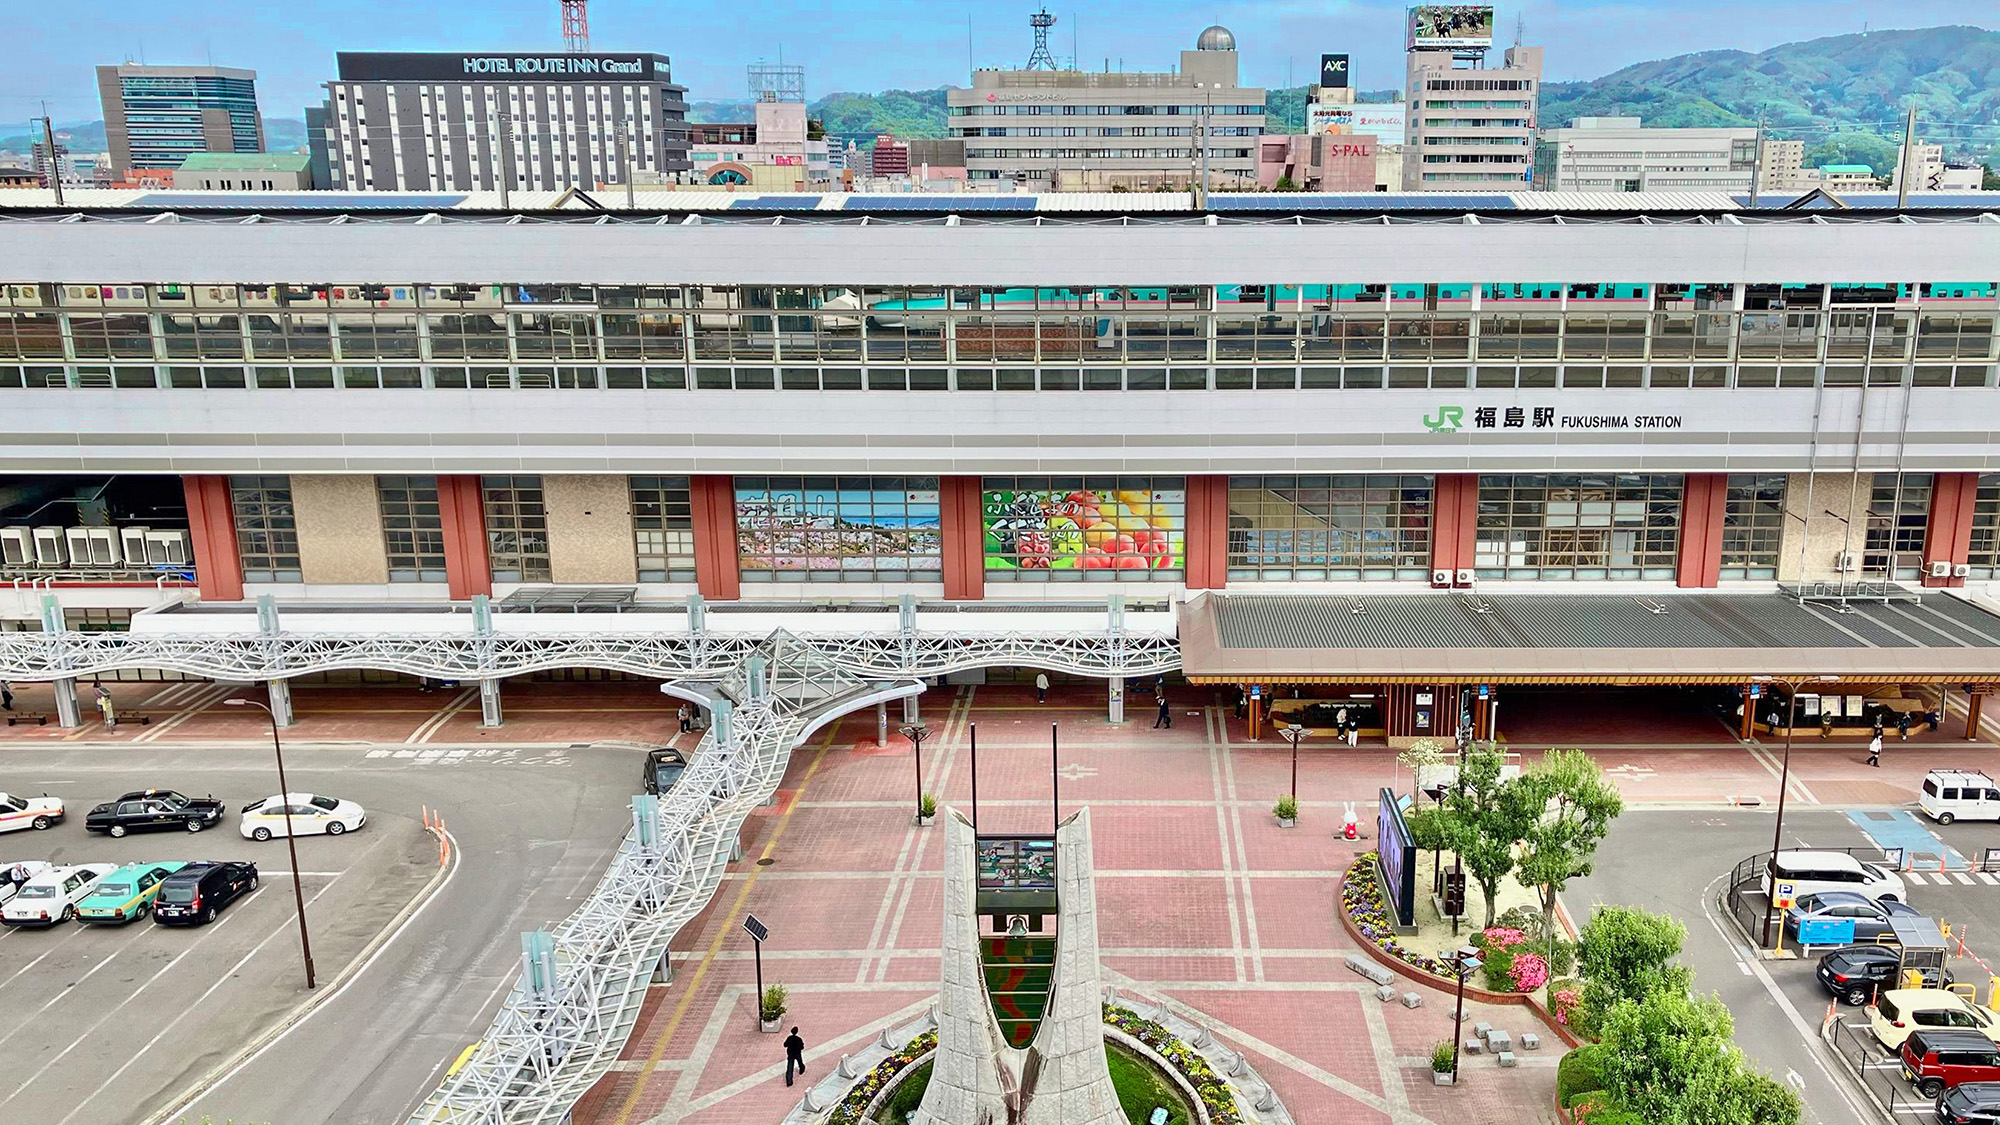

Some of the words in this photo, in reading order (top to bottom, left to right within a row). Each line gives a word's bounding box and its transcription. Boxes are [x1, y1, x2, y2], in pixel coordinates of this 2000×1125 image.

[463, 58, 512, 73] HOTEL
[515, 58, 564, 73] ROUTE
[566, 58, 599, 73] INN
[601, 58, 643, 73] Grand
[1324, 60, 1347, 71] AXC
[1423, 406, 1464, 428] JR
[1474, 406, 1555, 428] 福島駅
[1561, 416, 1629, 428] FUKUSHIMA
[1634, 416, 1682, 428] STATION
[987, 491, 1081, 517] ふくしまの
